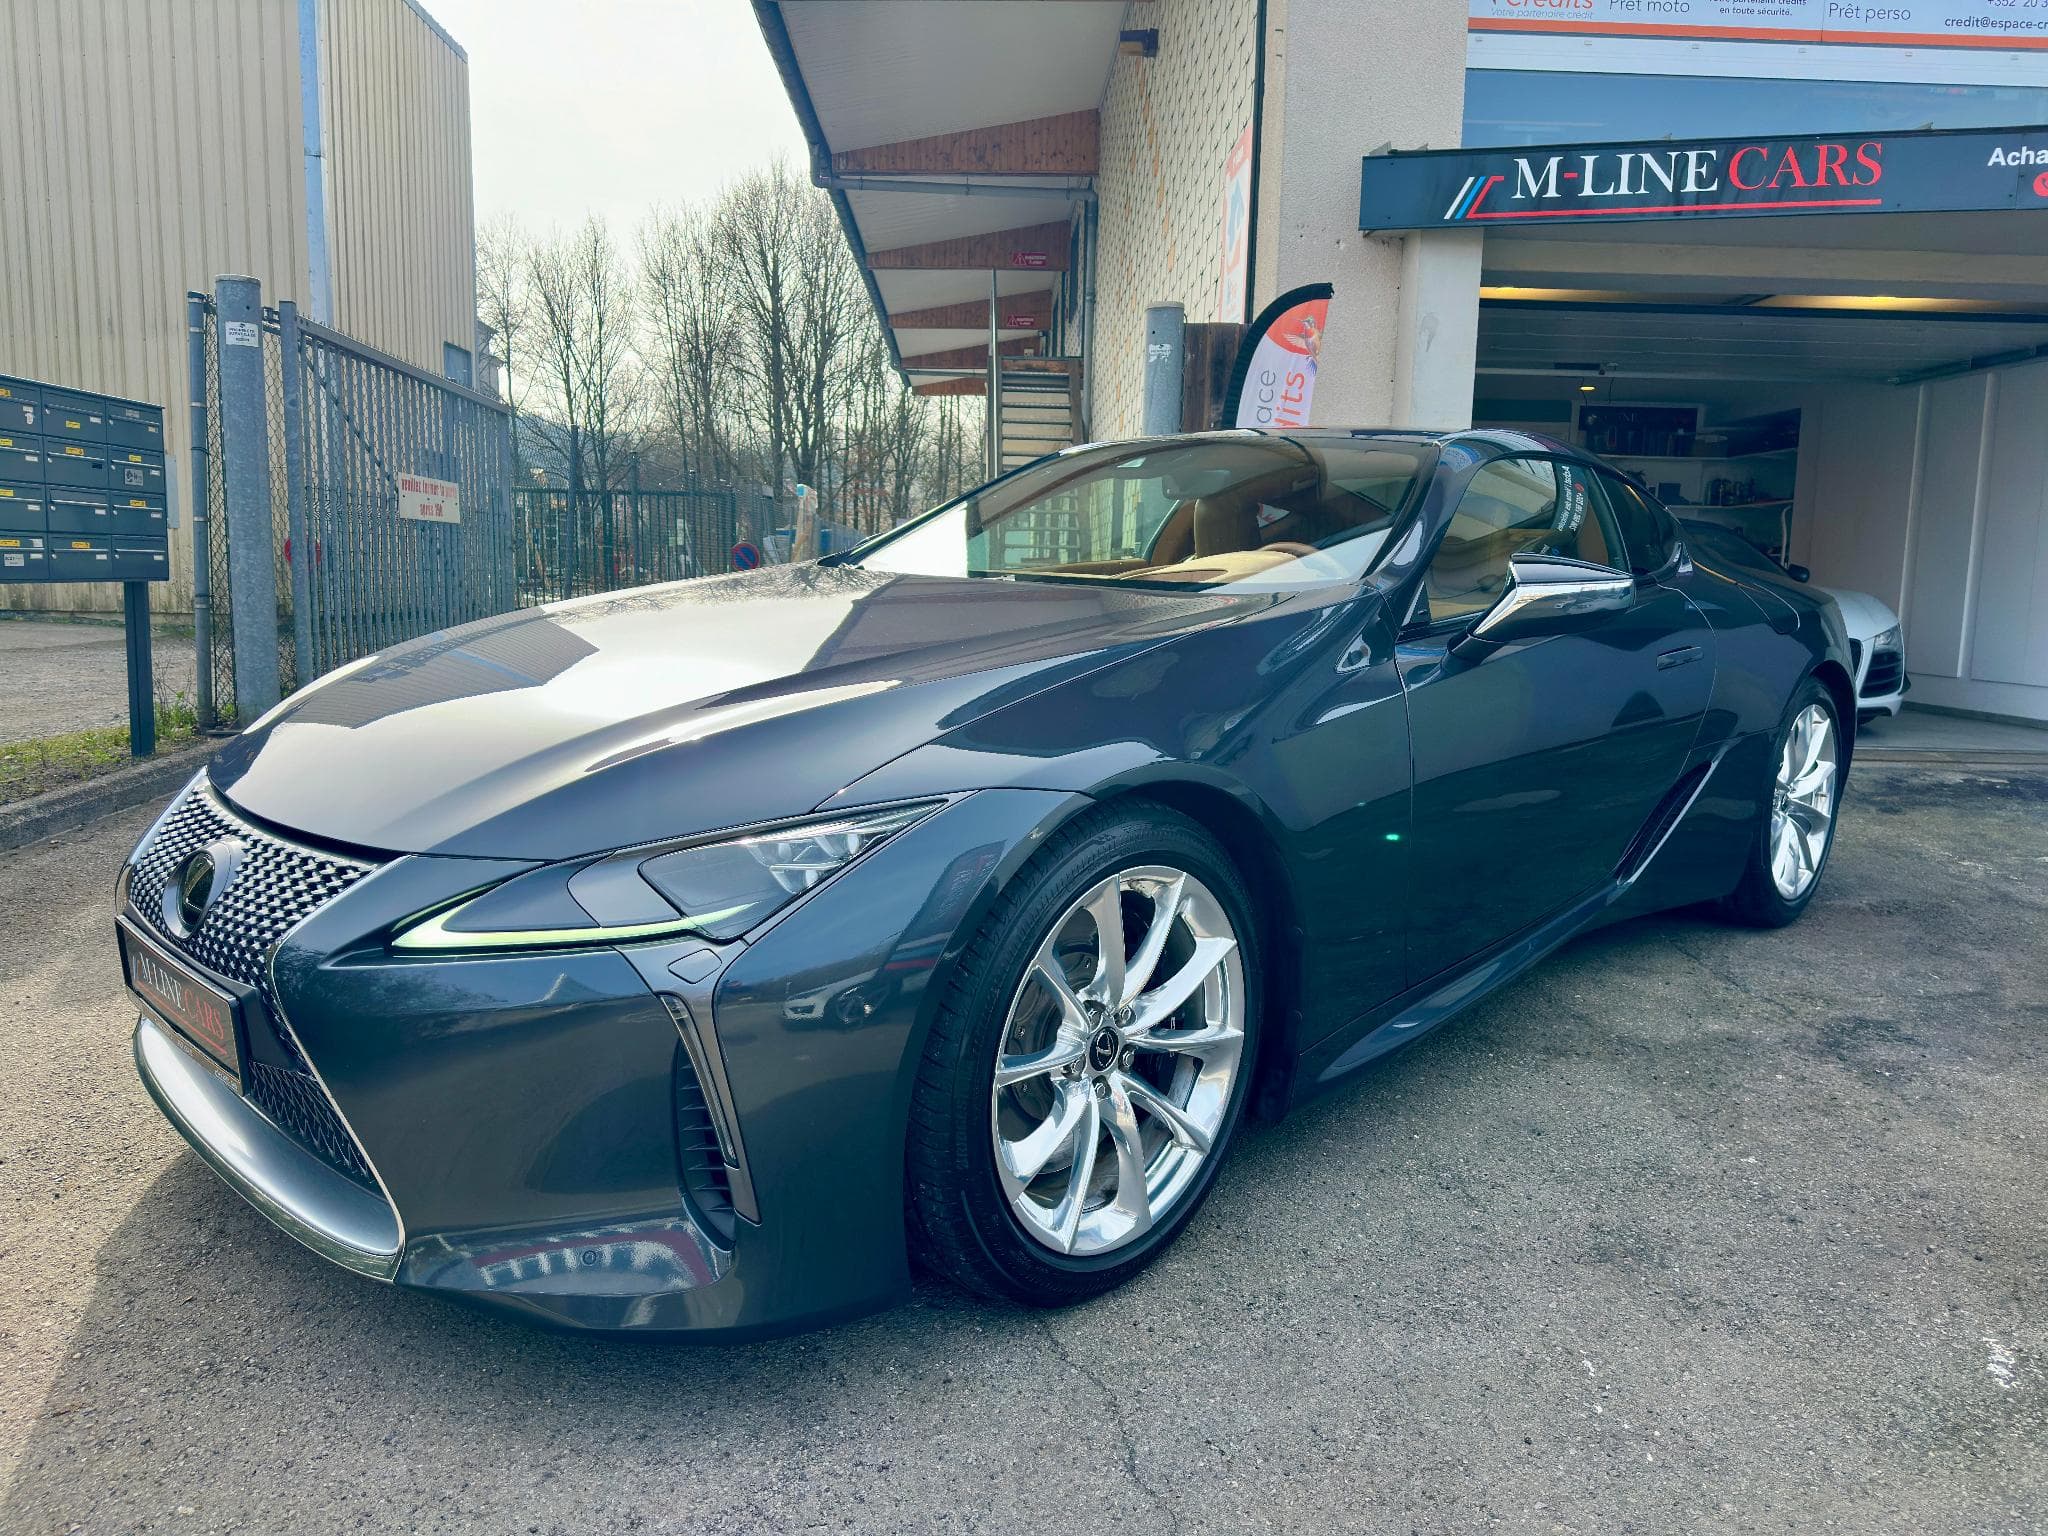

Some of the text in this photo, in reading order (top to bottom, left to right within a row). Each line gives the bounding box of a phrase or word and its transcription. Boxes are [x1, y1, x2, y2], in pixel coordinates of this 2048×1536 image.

[1647, 0, 1690, 13] moto
[1732, 7, 1755, 15] toute
[1829, 2, 1911, 23] Prêt perso
[1986, 145, 2048, 167] Acha
[1511, 141, 1883, 200] M-LINE CARS
[184, 987, 225, 1040] CARS
